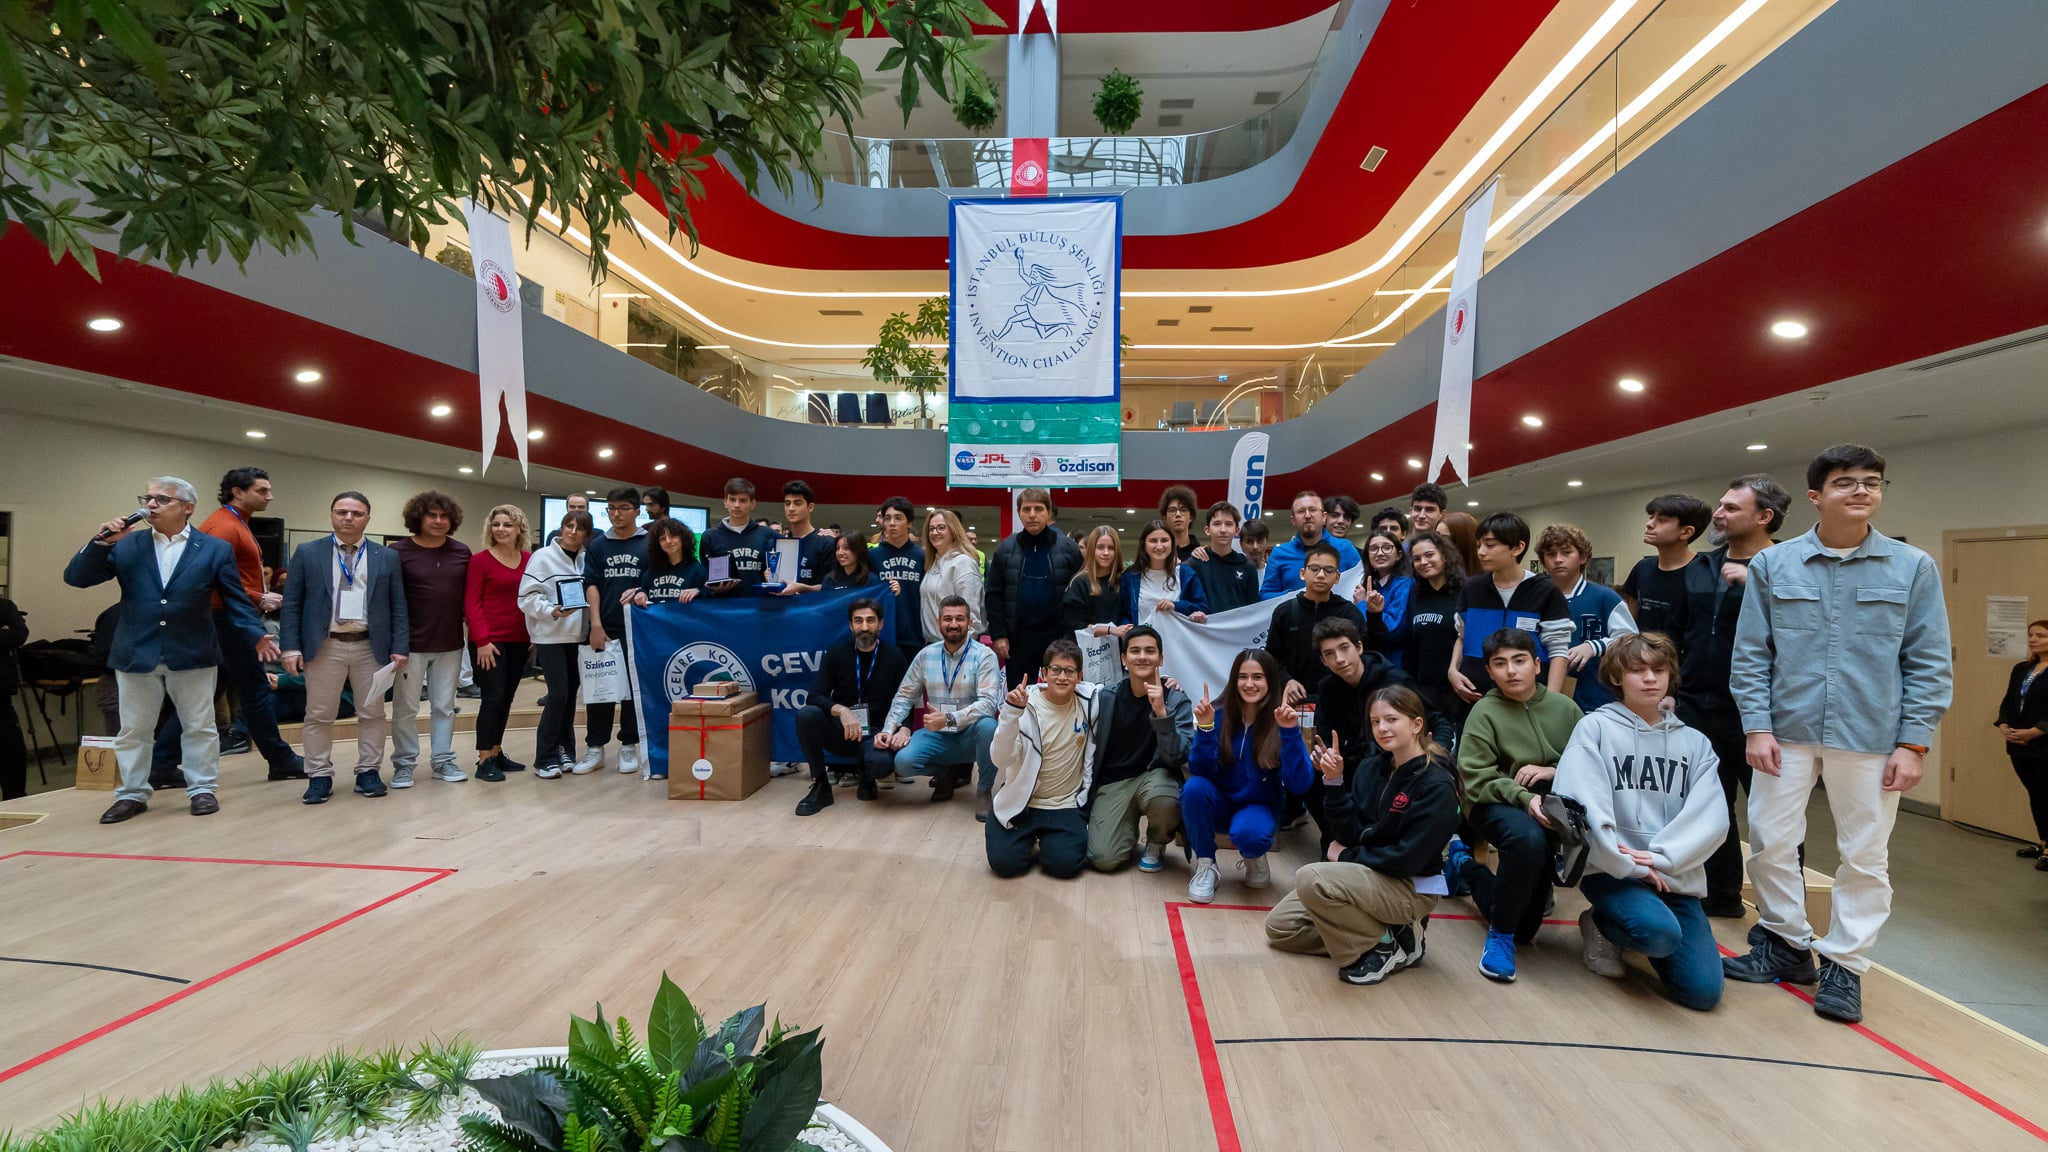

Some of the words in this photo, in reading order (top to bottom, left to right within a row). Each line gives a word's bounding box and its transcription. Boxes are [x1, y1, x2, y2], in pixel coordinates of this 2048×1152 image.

[966, 237, 1017, 298] İSTANBUL
[1019, 231, 1067, 250] BULUŞ
[1068, 243, 1106, 297] ŞENLİĞİ
[968, 311, 1029, 368] INVENTION
[1033, 308, 1102, 370] CHALLENGE
[956, 456, 975, 464] NASA
[979, 453, 1011, 464] JPL
[1057, 458, 1115, 473] özdisan
[731, 547, 760, 559] EVRE
[606, 554, 640, 566] ÇEVRE
[882, 556, 917, 569] ÇEVRE
[604, 567, 641, 578] COLLEGE
[879, 570, 920, 582] COLLEGE
[653, 575, 685, 587] ÇEVRE
[649, 588, 682, 599] COLLEG
[1086, 642, 1111, 658] özdan
[761, 650, 827, 677] ÇEV
[671, 652, 695, 696] ÇEVRE
[1612, 754, 1689, 798] MAVİ
